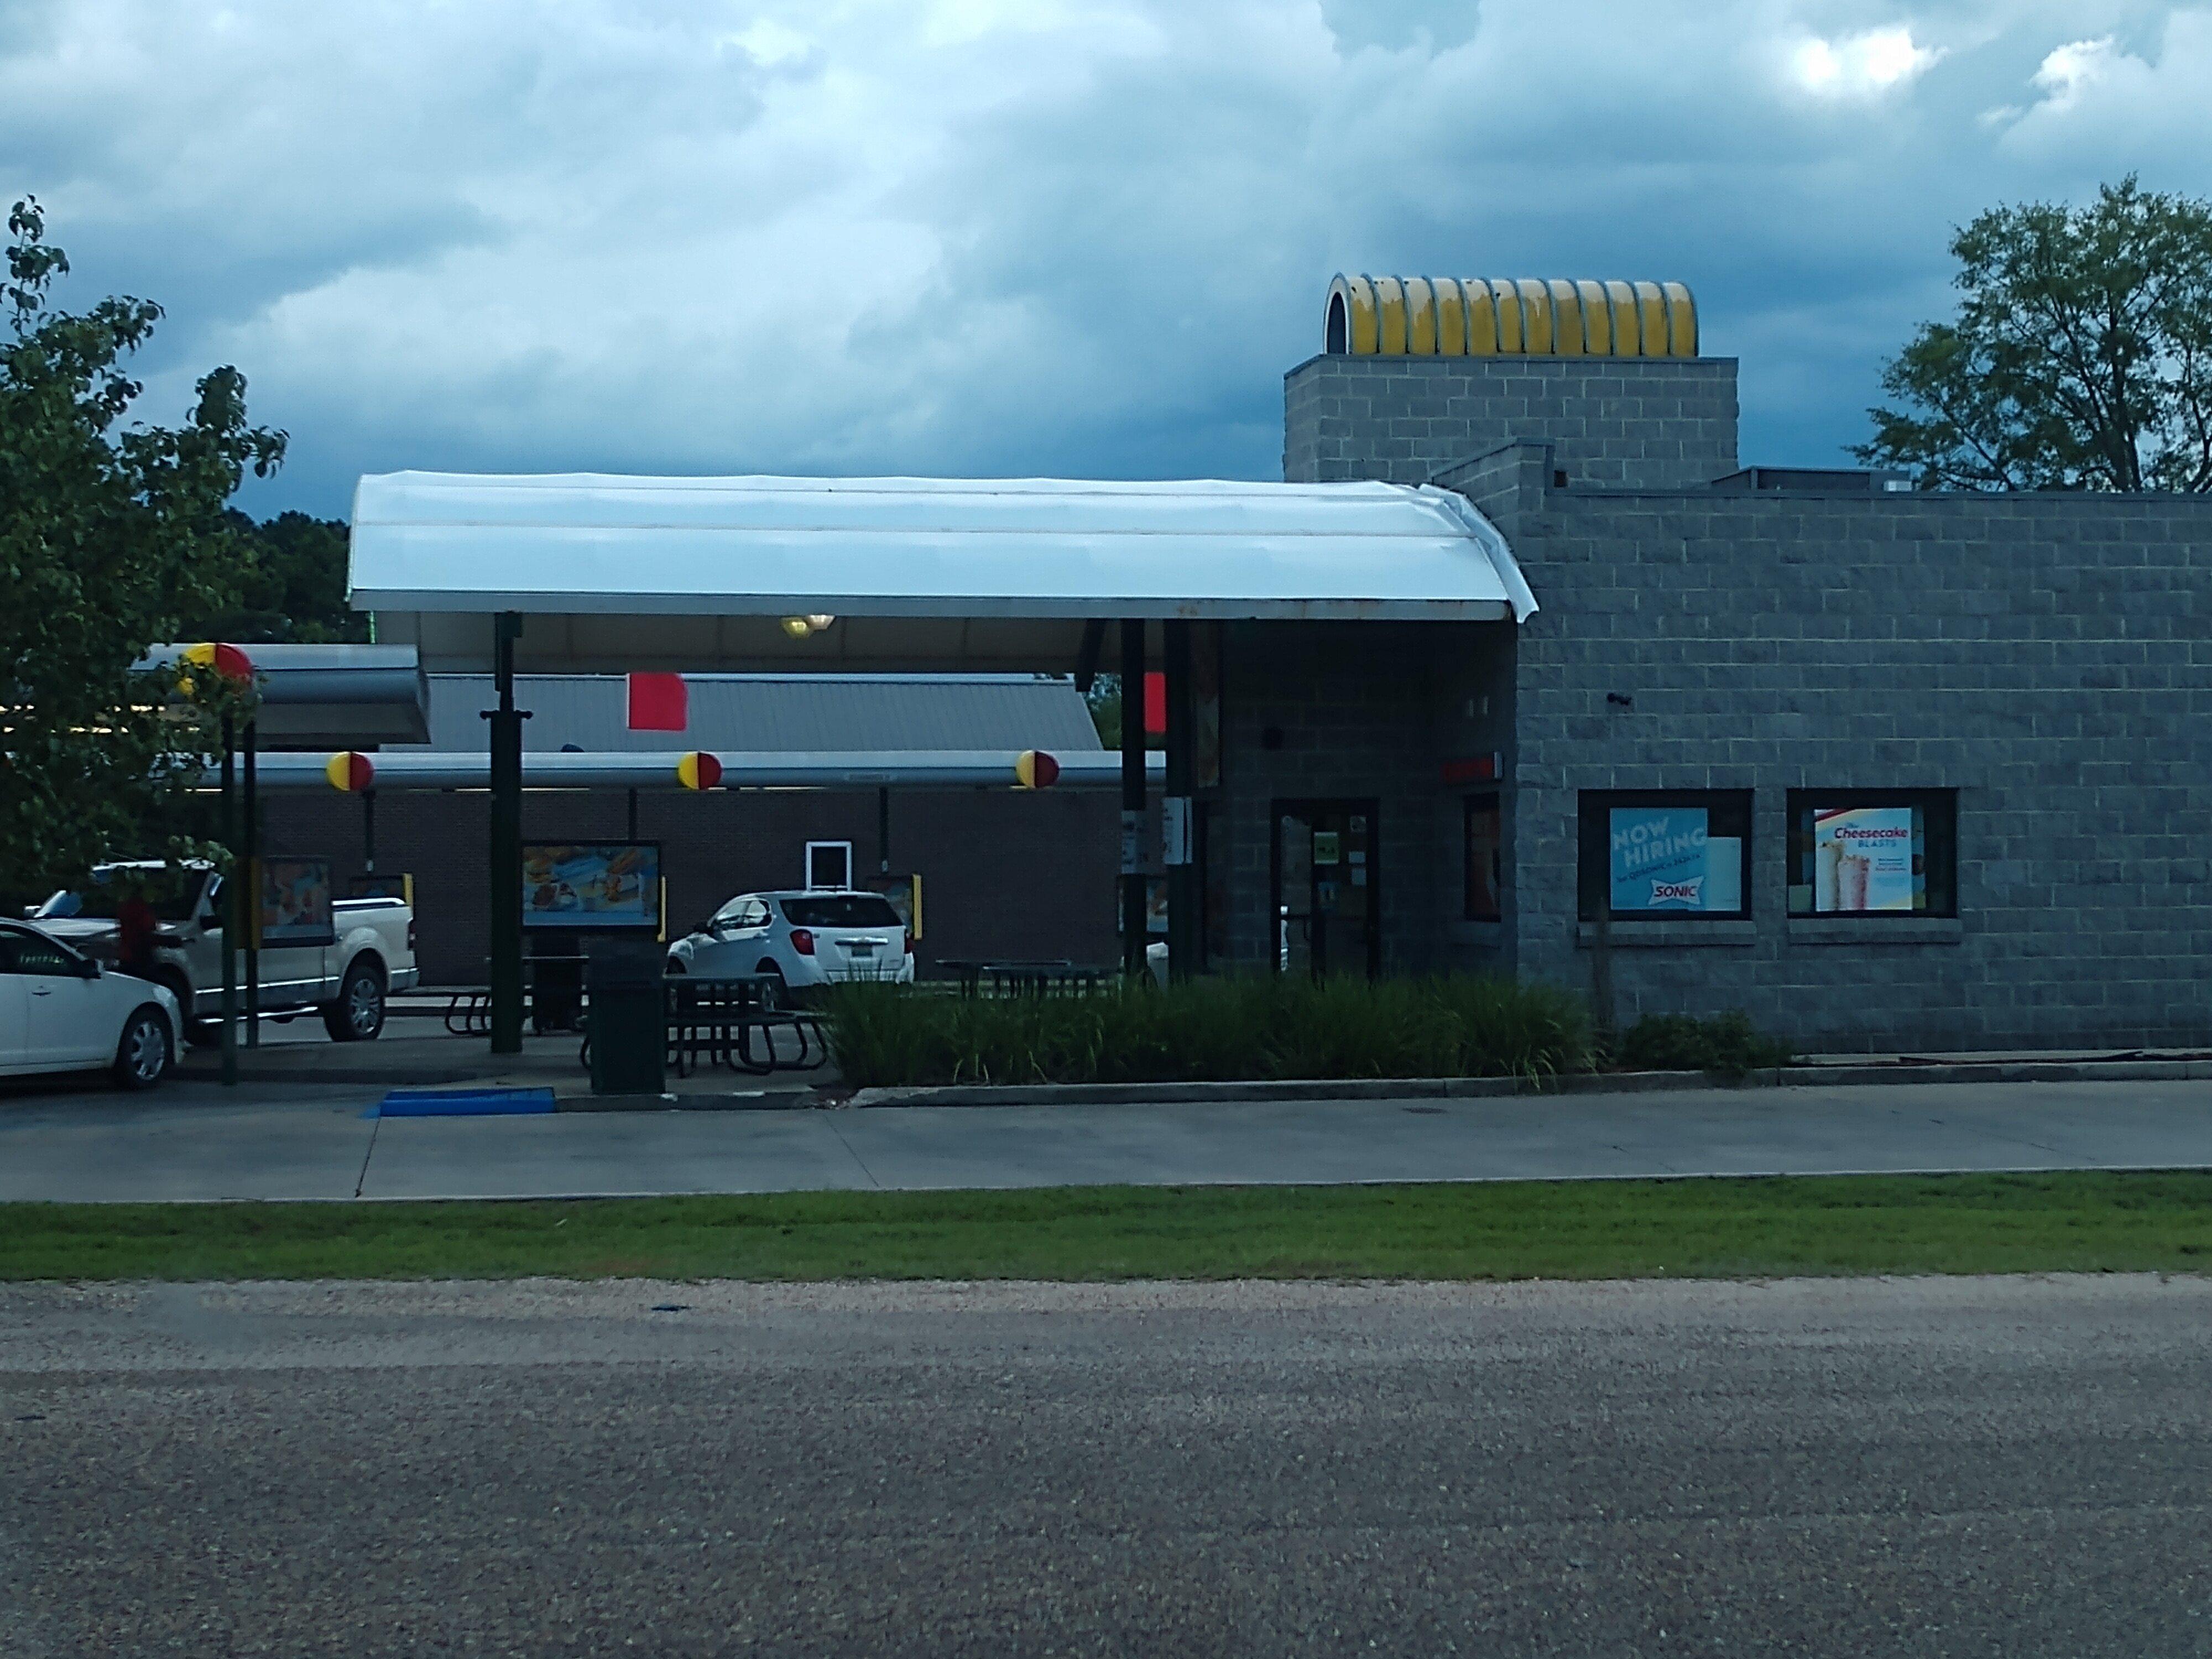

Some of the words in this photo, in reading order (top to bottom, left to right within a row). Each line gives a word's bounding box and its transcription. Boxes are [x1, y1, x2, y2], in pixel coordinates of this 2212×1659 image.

[1614, 816, 1669, 850] NOW
[1835, 827, 1908, 838] Cheesecake
[1624, 827, 1707, 868] HIRING
[1654, 886, 1697, 897] SONIC
